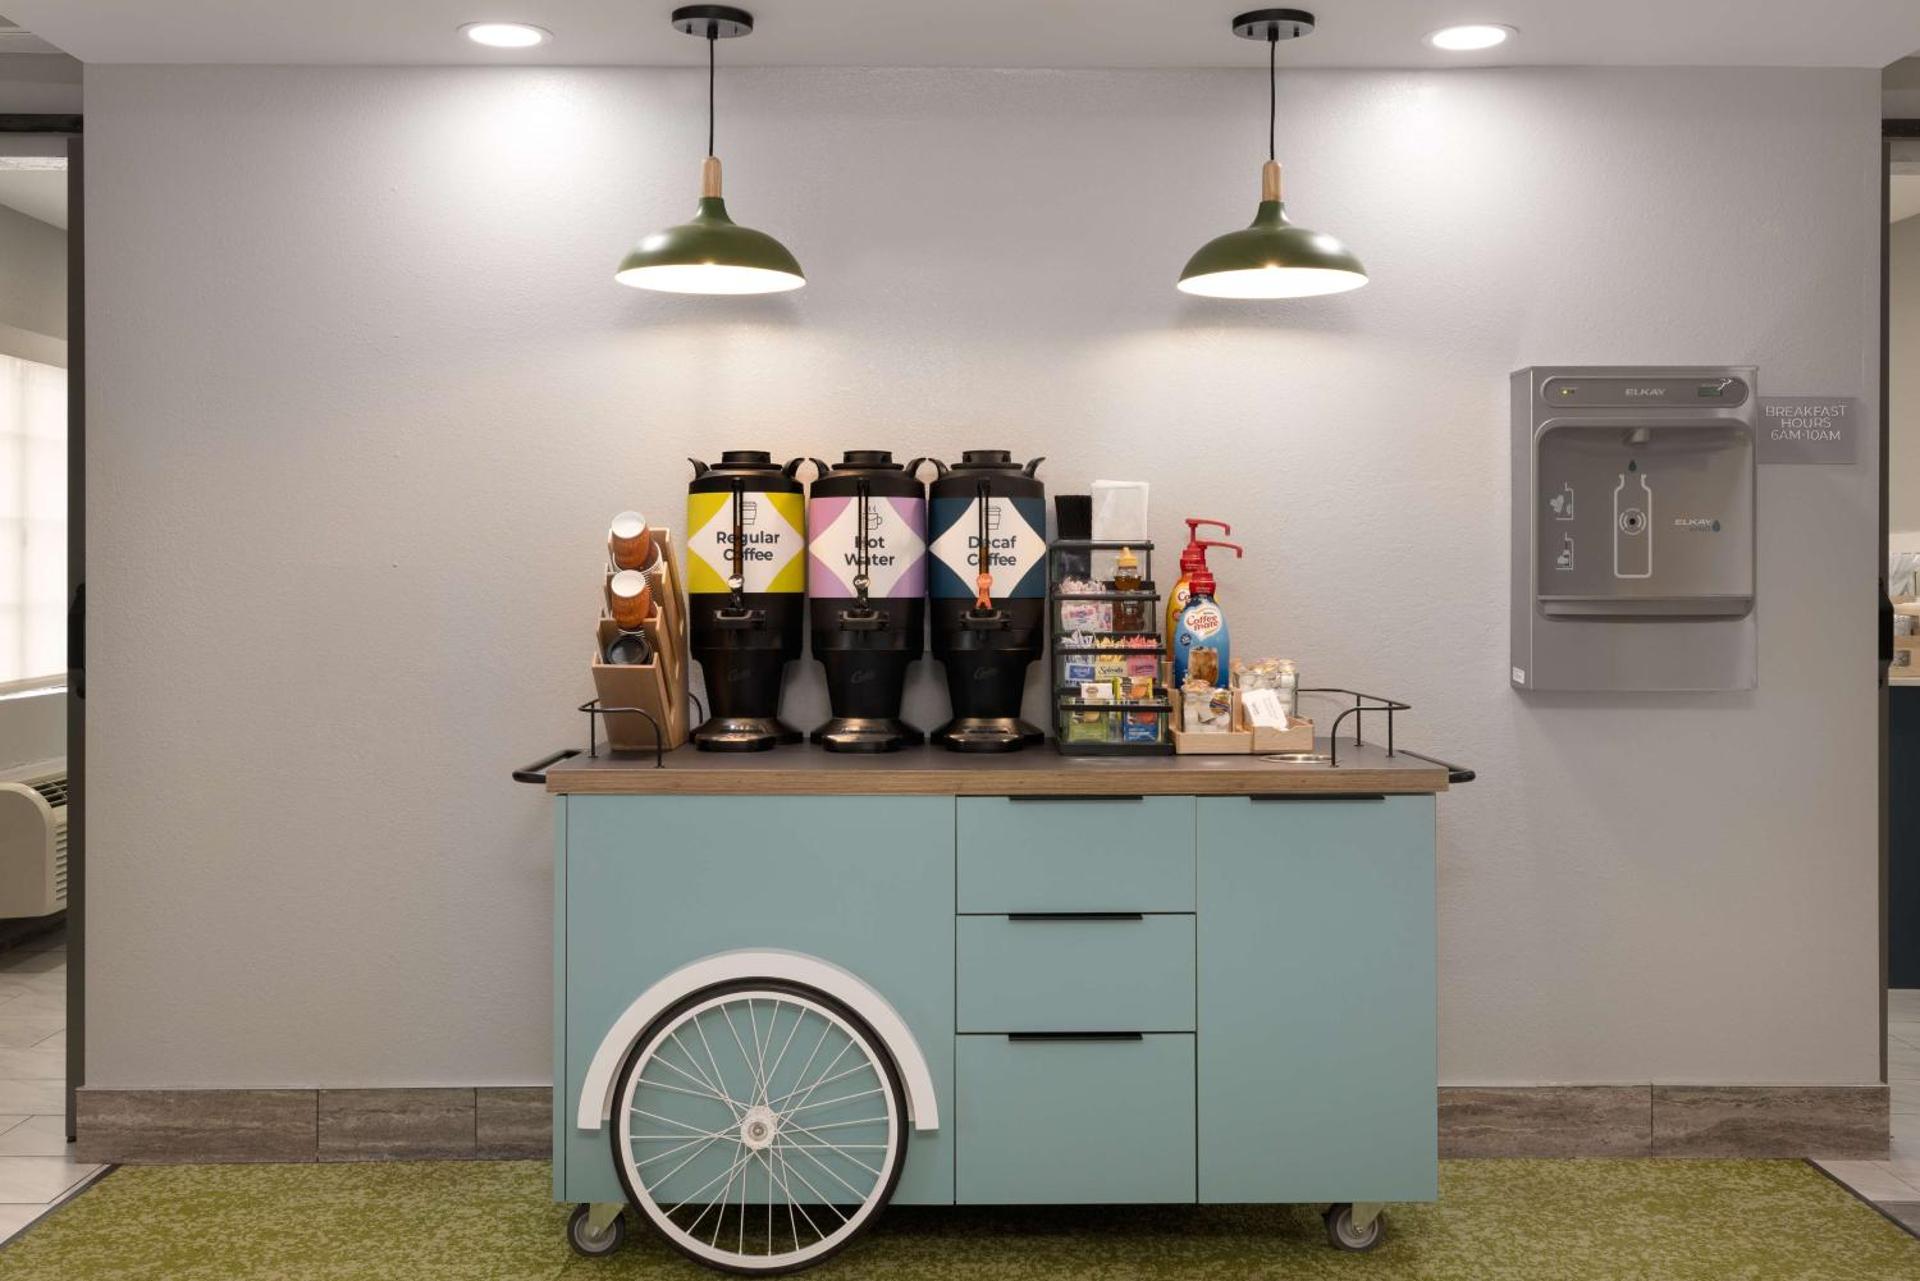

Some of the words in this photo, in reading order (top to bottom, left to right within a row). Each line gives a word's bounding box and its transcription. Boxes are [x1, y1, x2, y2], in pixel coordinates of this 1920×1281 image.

[1624, 388, 1667, 396] ELKAY
[1765, 405, 1848, 417] BREAKFAST
[1781, 417, 1832, 428] HOURS
[723, 547, 774, 561] Cffee
[967, 552, 1017, 566] Cffee
[1187, 614, 1218, 626] Coffee
